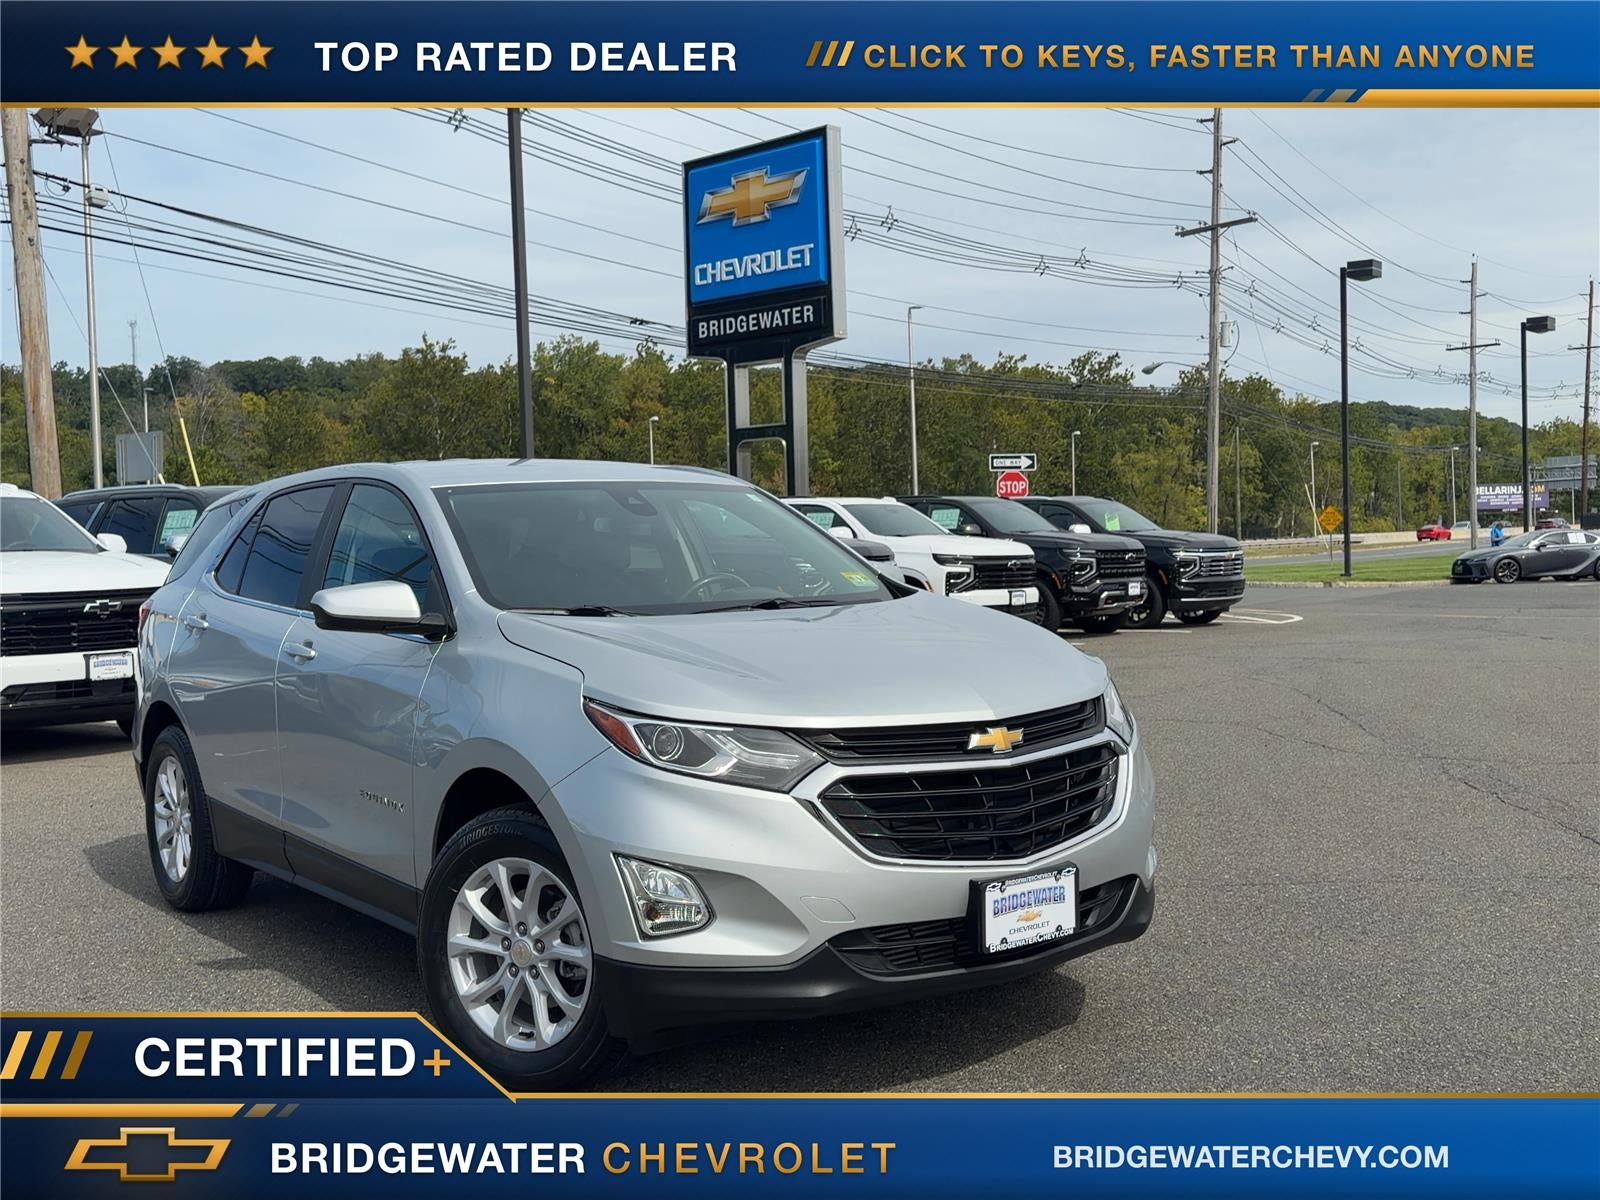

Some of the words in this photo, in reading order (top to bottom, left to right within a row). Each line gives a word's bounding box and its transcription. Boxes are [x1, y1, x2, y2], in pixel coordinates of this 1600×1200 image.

[694, 243, 814, 286] CHEVROLET
[698, 305, 814, 338] BRIDGEWATER
[999, 481, 1026, 494] STOP
[993, 886, 1065, 918] BRIDGEWATER
[1009, 921, 1050, 935] CHEVROLET
